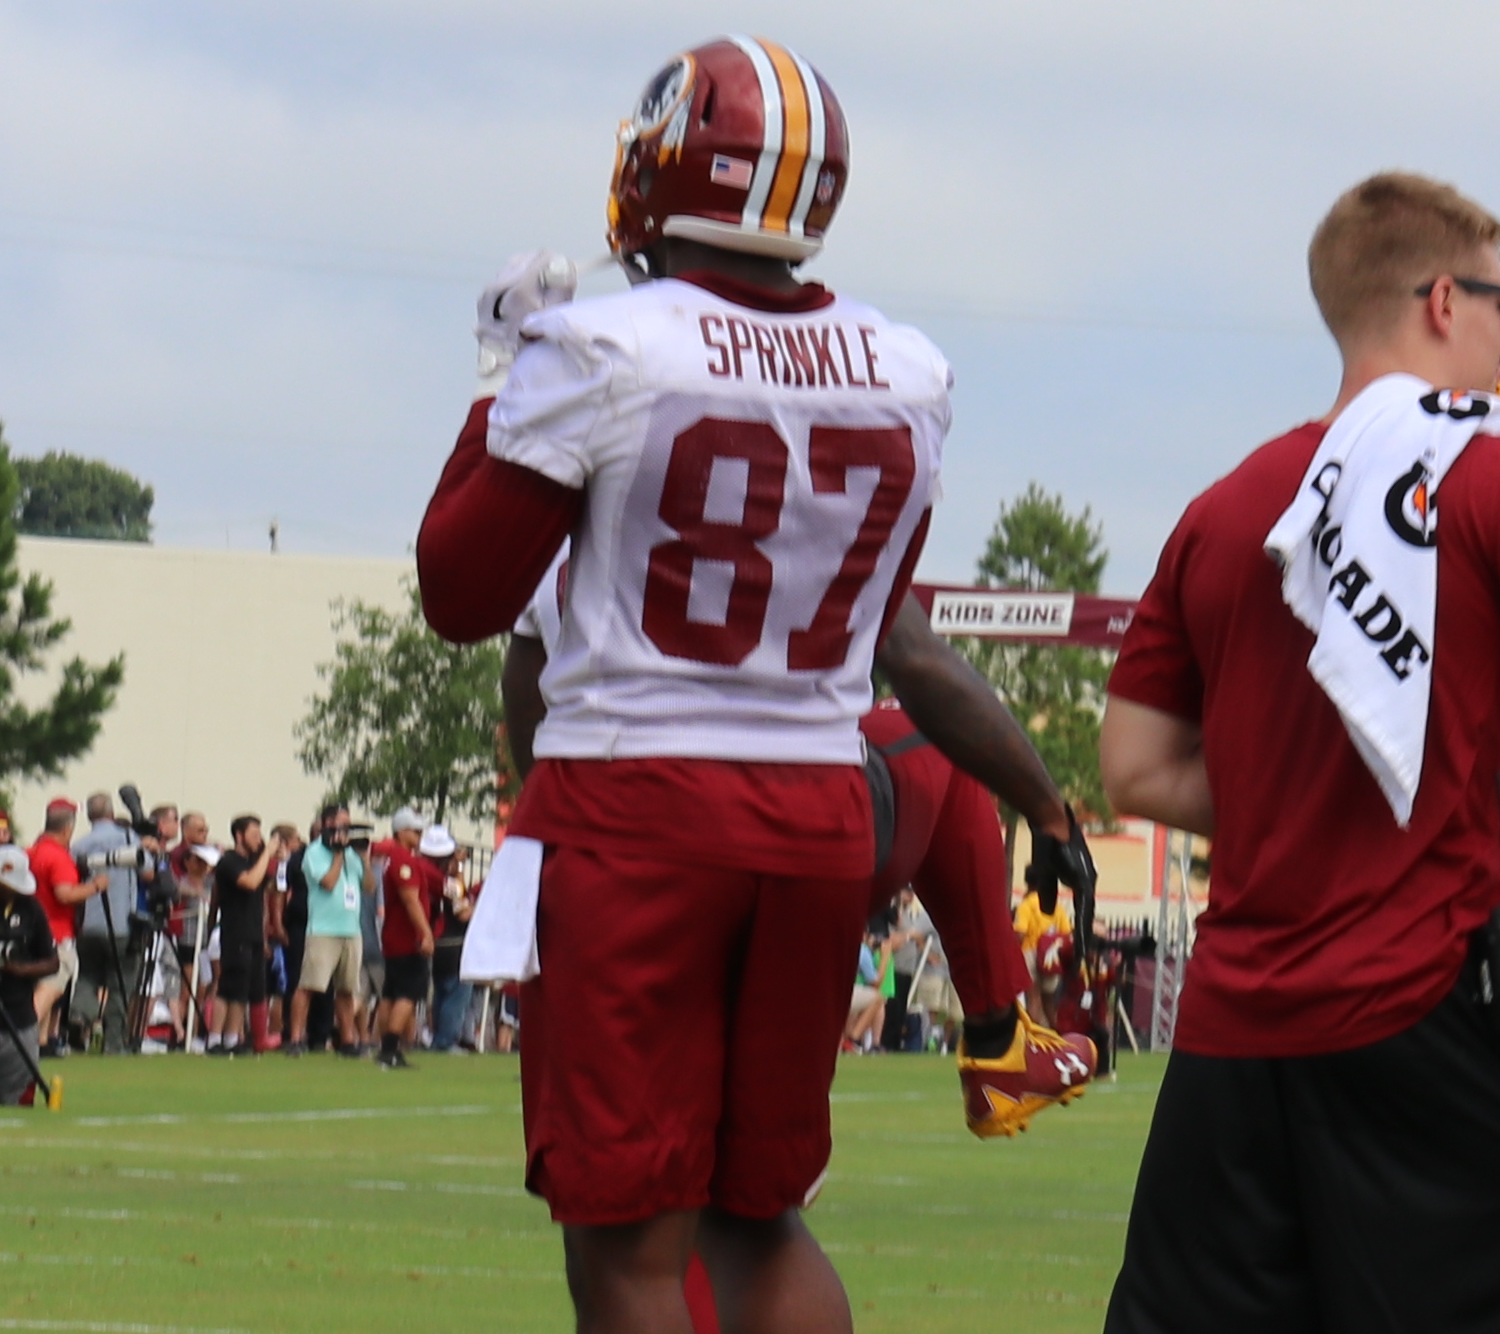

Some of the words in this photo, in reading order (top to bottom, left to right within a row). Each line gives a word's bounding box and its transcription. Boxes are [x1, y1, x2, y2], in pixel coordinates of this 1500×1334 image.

[699, 314, 890, 390] SPRINKLE
[642, 417, 916, 673] 87
[939, 603, 993, 625] KIDS
[1002, 603, 1064, 627] ZONE
